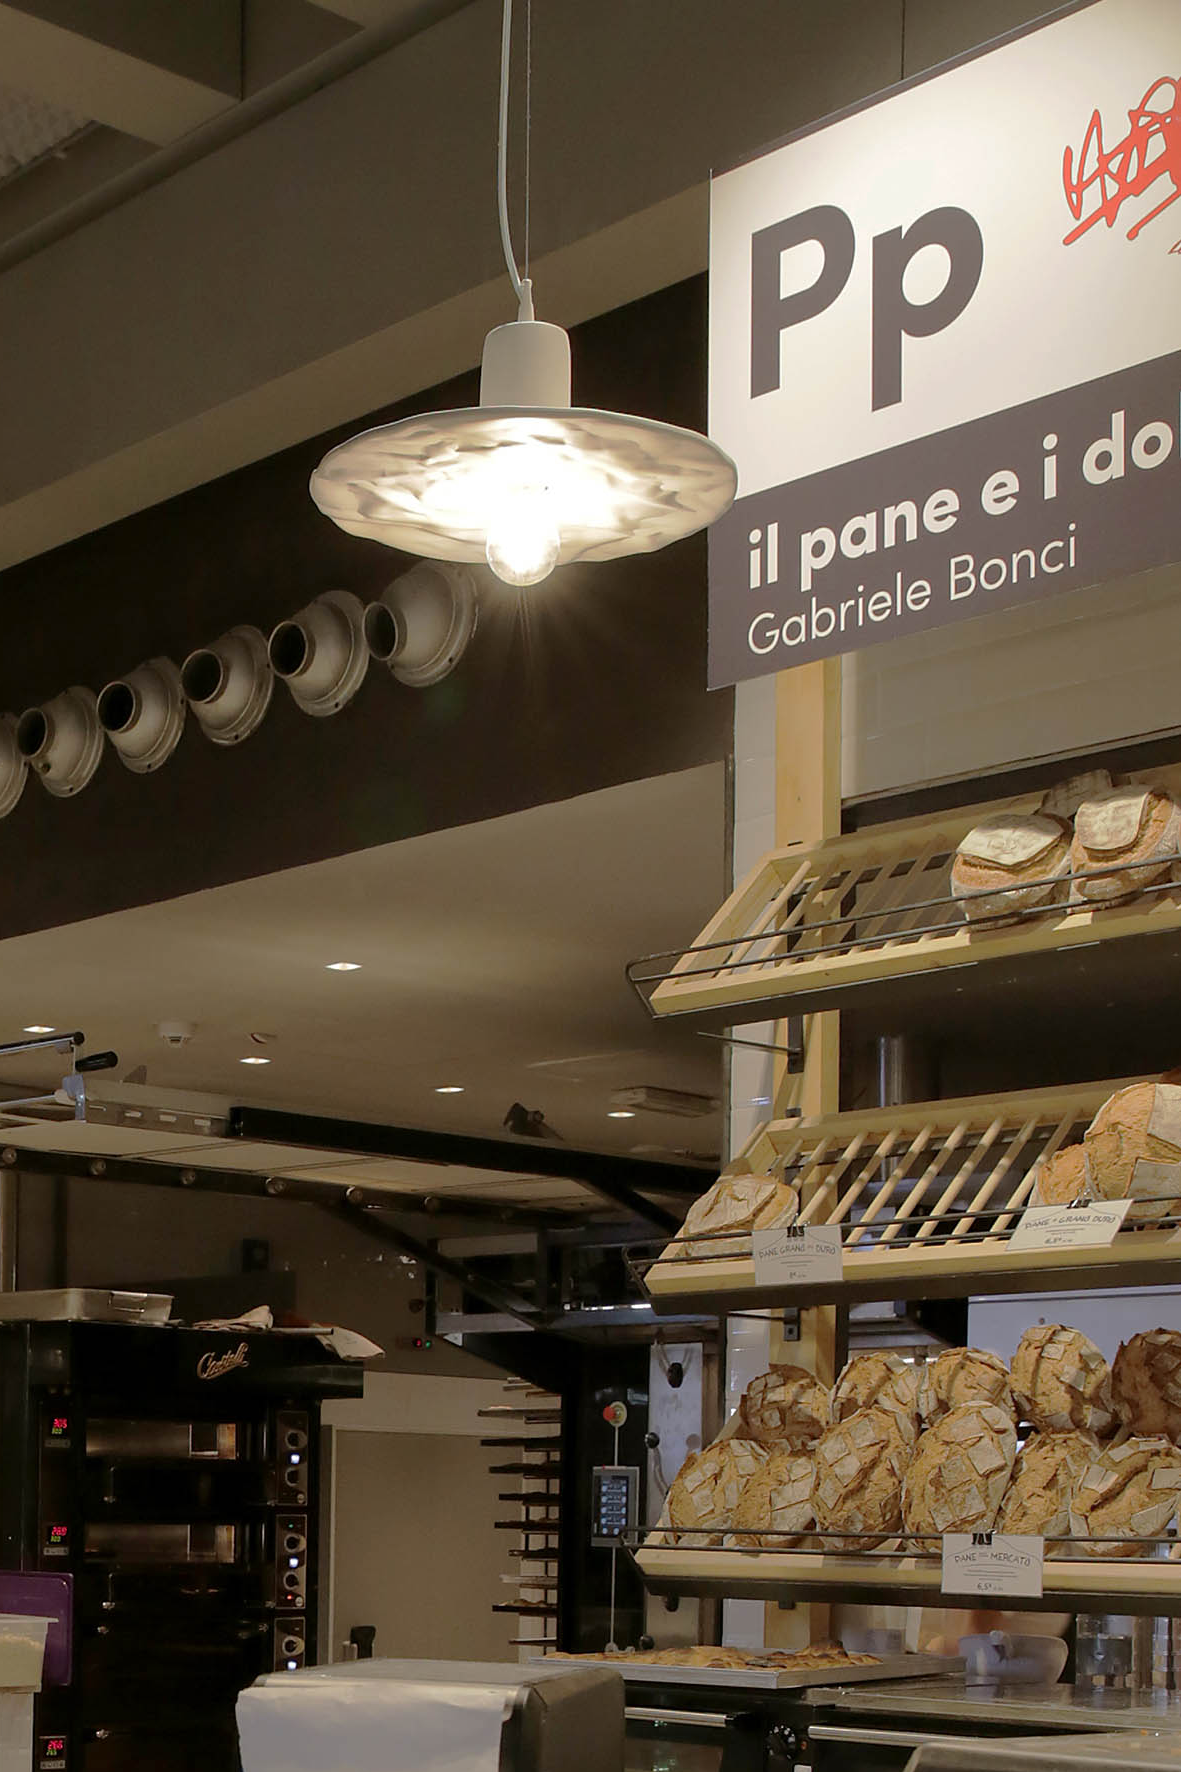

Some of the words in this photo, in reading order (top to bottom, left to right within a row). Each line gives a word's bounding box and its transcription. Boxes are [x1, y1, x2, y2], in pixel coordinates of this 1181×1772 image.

[750, 204, 984, 413] Pp
[748, 522, 779, 590] il
[800, 488, 960, 592] pane
[981, 469, 1020, 517] e
[1042, 433, 1058, 500] i
[1081, 392, 1181, 486] do
[747, 571, 932, 656] Gabriele
[947, 523, 1077, 601] Bonci
[954, 1552, 977, 1563] PANE
[989, 1552, 1031, 1568] MERCATO
